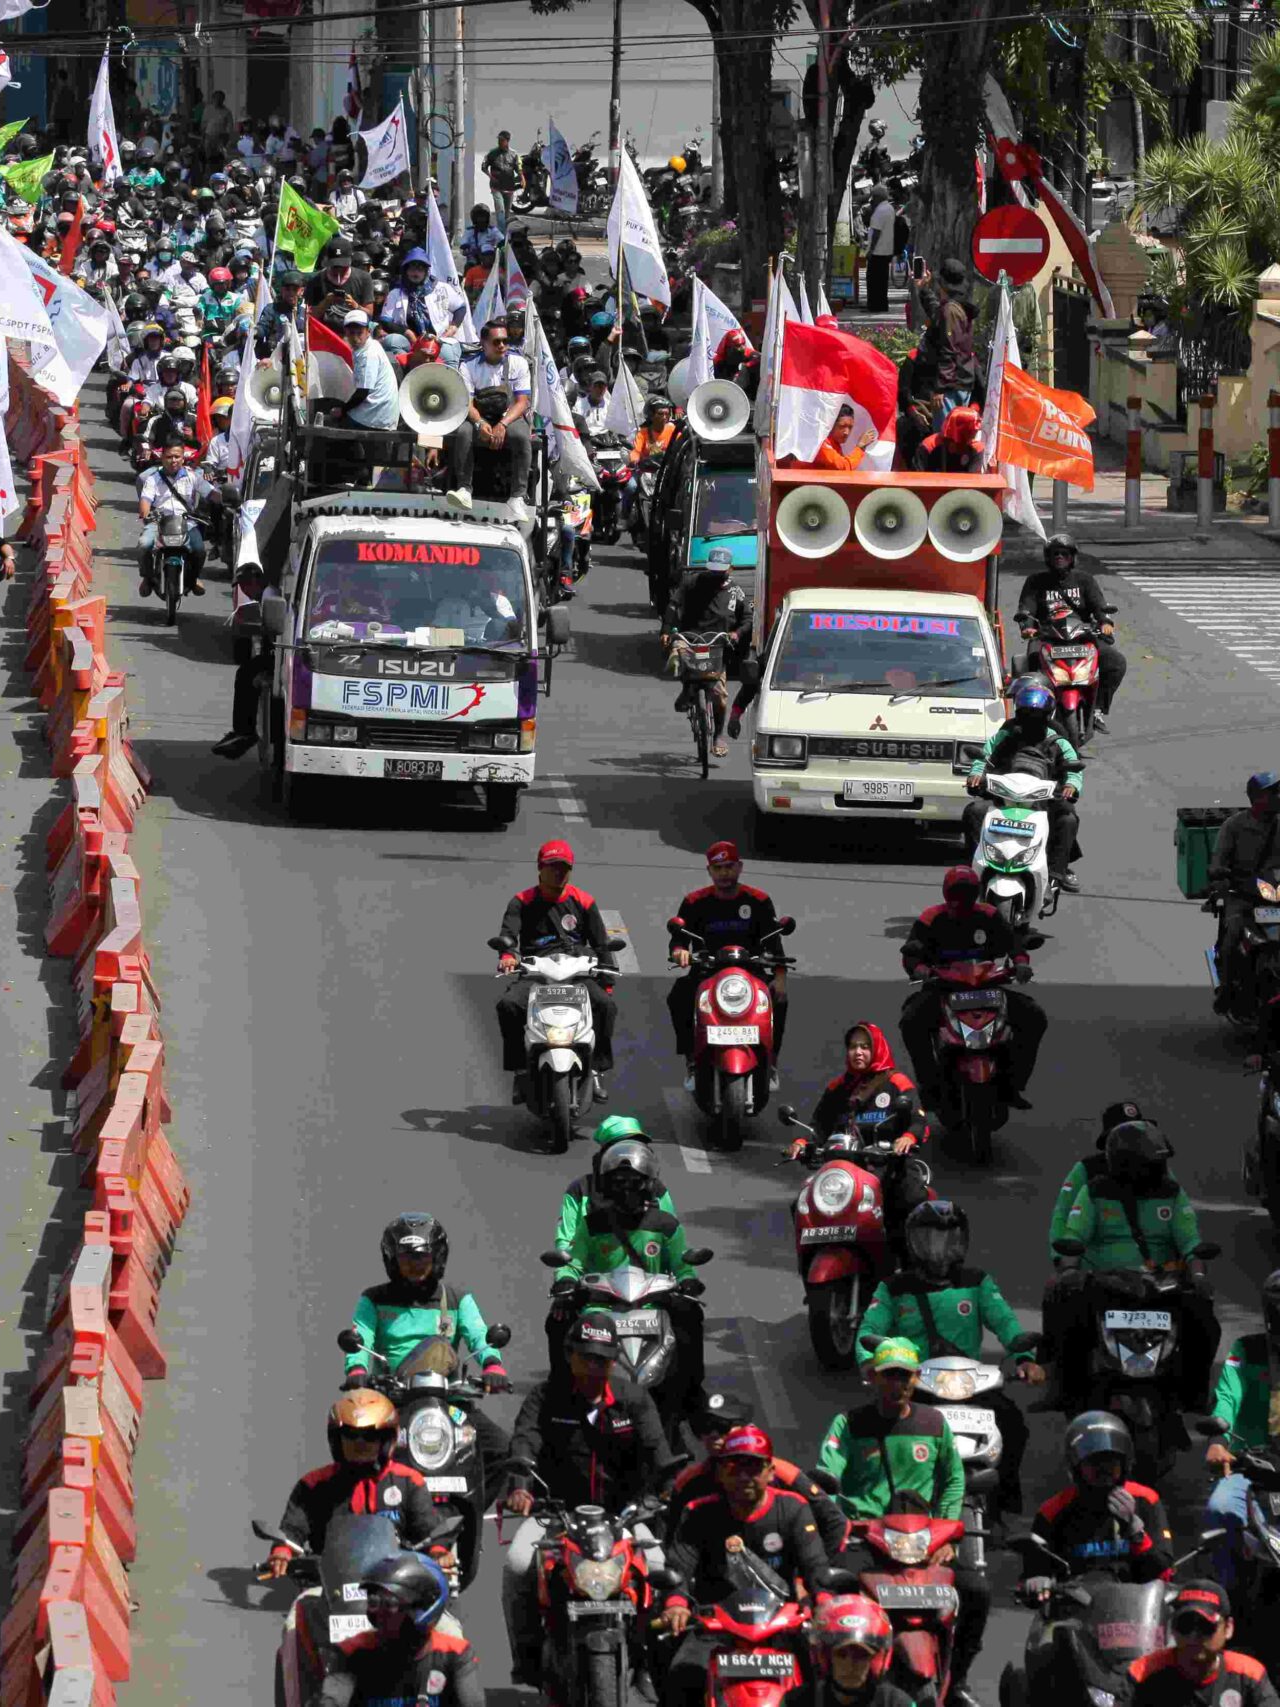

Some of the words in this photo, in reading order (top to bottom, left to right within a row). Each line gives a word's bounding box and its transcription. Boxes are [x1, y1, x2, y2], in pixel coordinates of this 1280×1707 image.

[358, 542, 481, 566] KOMANDO
[809, 613, 959, 636] RESOLUSI
[378, 659, 455, 676] ISUZU
[343, 681, 450, 710] FSPMI
[845, 782, 853, 794] W
[864, 782, 889, 794] 9985
[899, 783, 912, 795] PD
[718, 1655, 728, 1666] W
[732, 1655, 762, 1666] 6647
